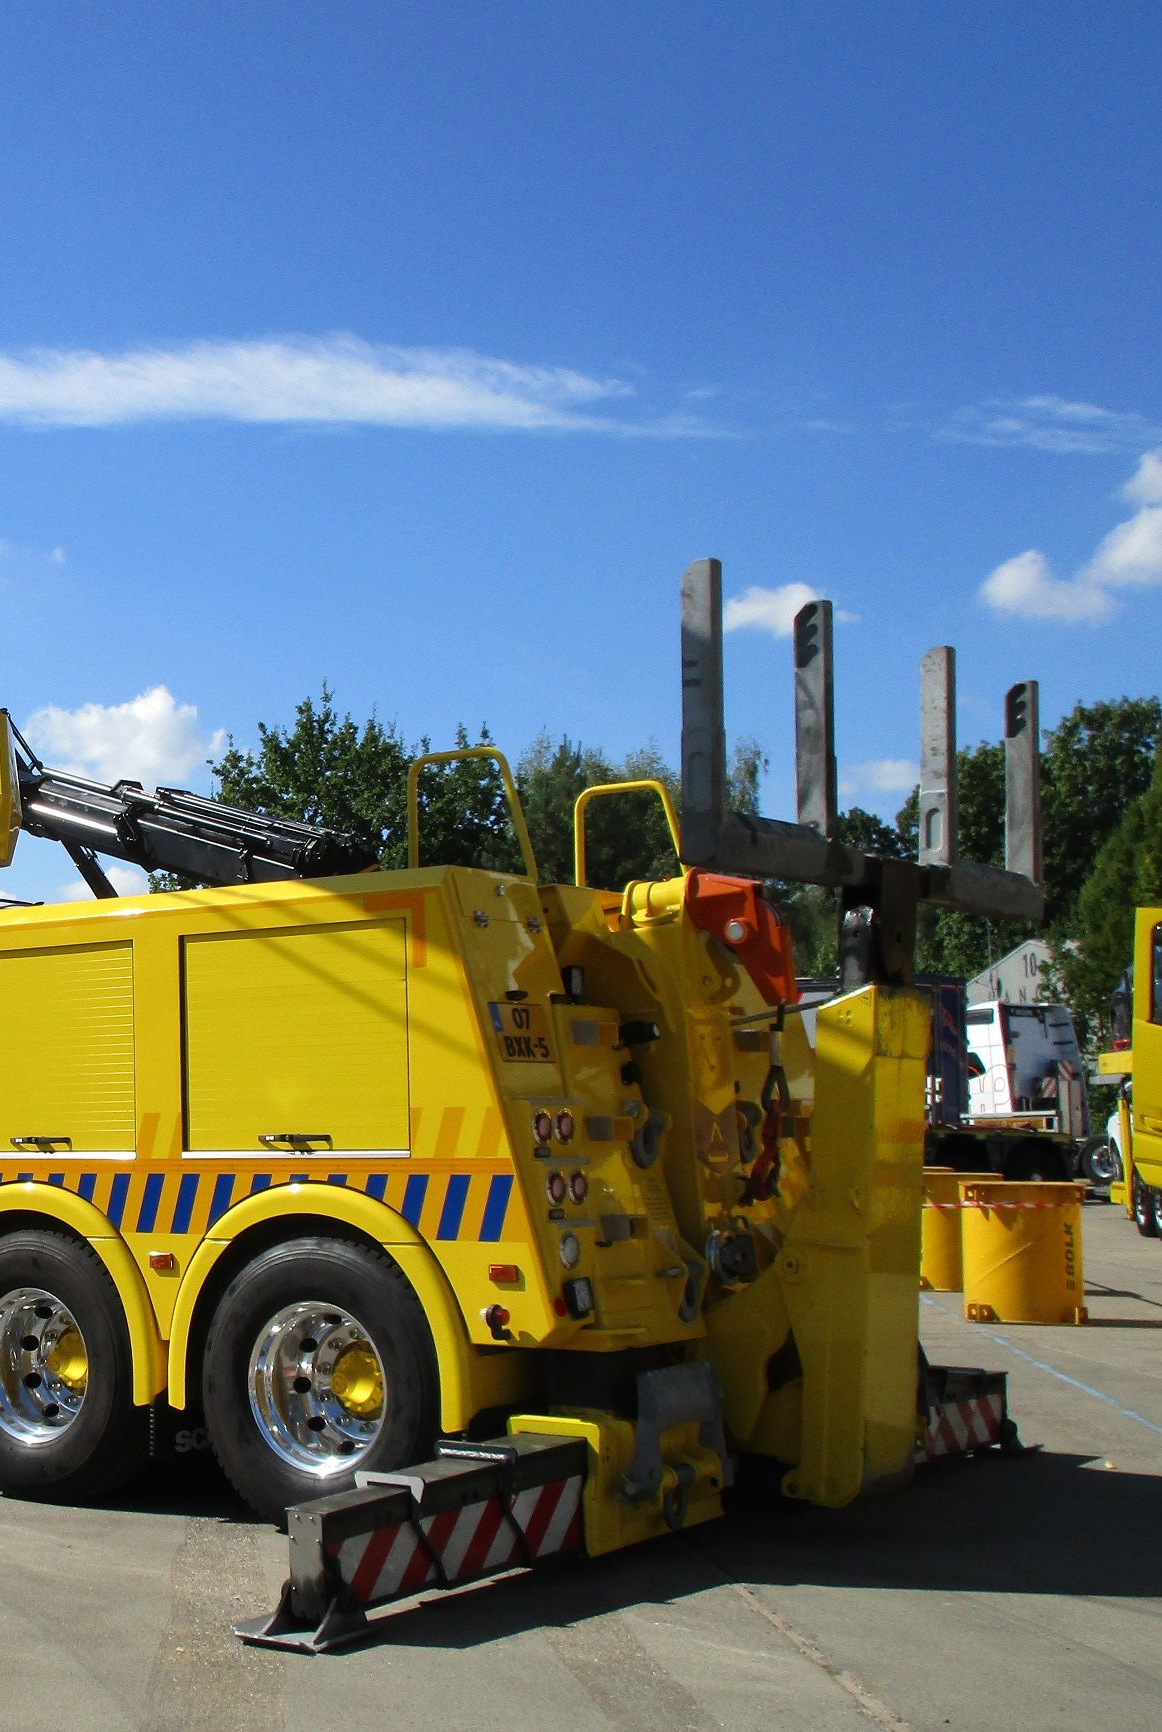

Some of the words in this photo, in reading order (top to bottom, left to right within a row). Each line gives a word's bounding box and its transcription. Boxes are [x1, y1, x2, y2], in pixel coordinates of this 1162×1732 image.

[1023, 952, 1037, 978] 10
[512, 1007, 530, 1030] 07
[503, 1035, 550, 1058] BXK-5
